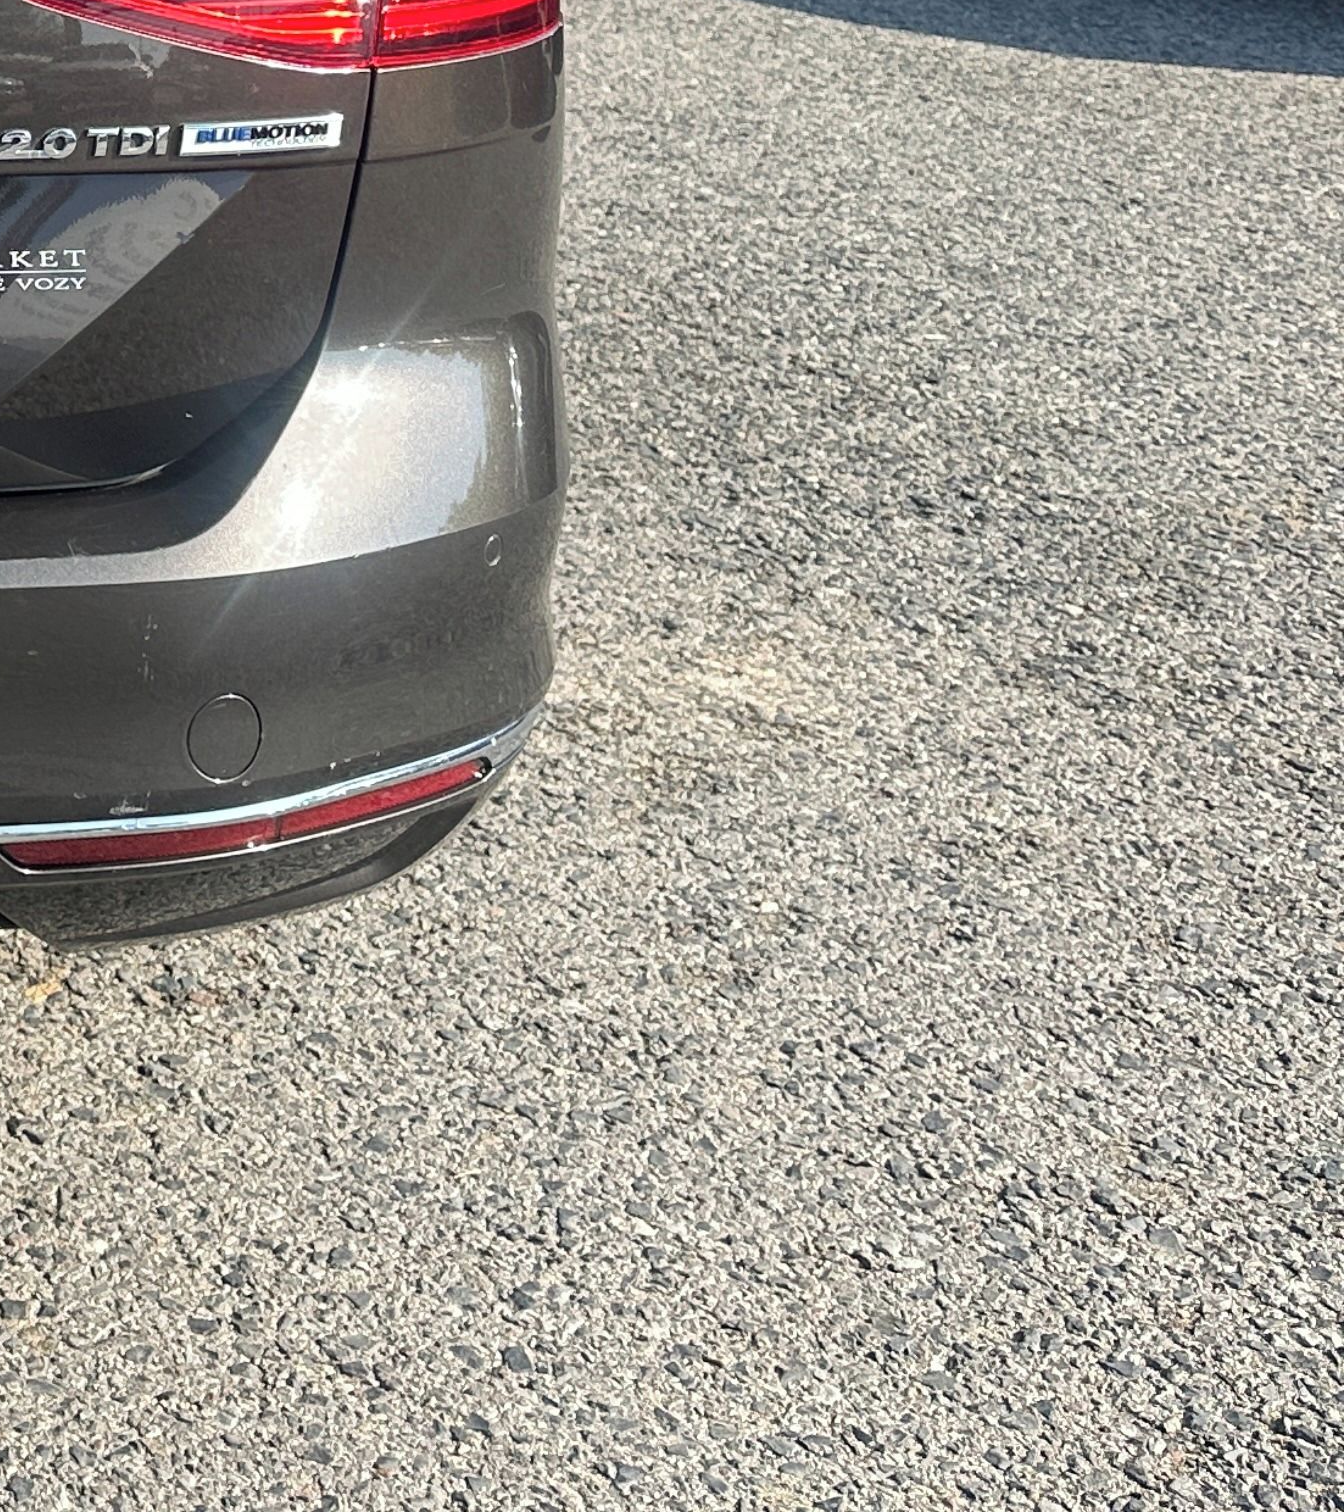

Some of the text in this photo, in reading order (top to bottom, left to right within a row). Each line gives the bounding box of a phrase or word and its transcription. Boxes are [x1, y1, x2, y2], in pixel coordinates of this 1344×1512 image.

[86, 125, 171, 157] TDI
[195, 122, 329, 144] BLUEMOTION
[16, 277, 87, 291] VOZY
